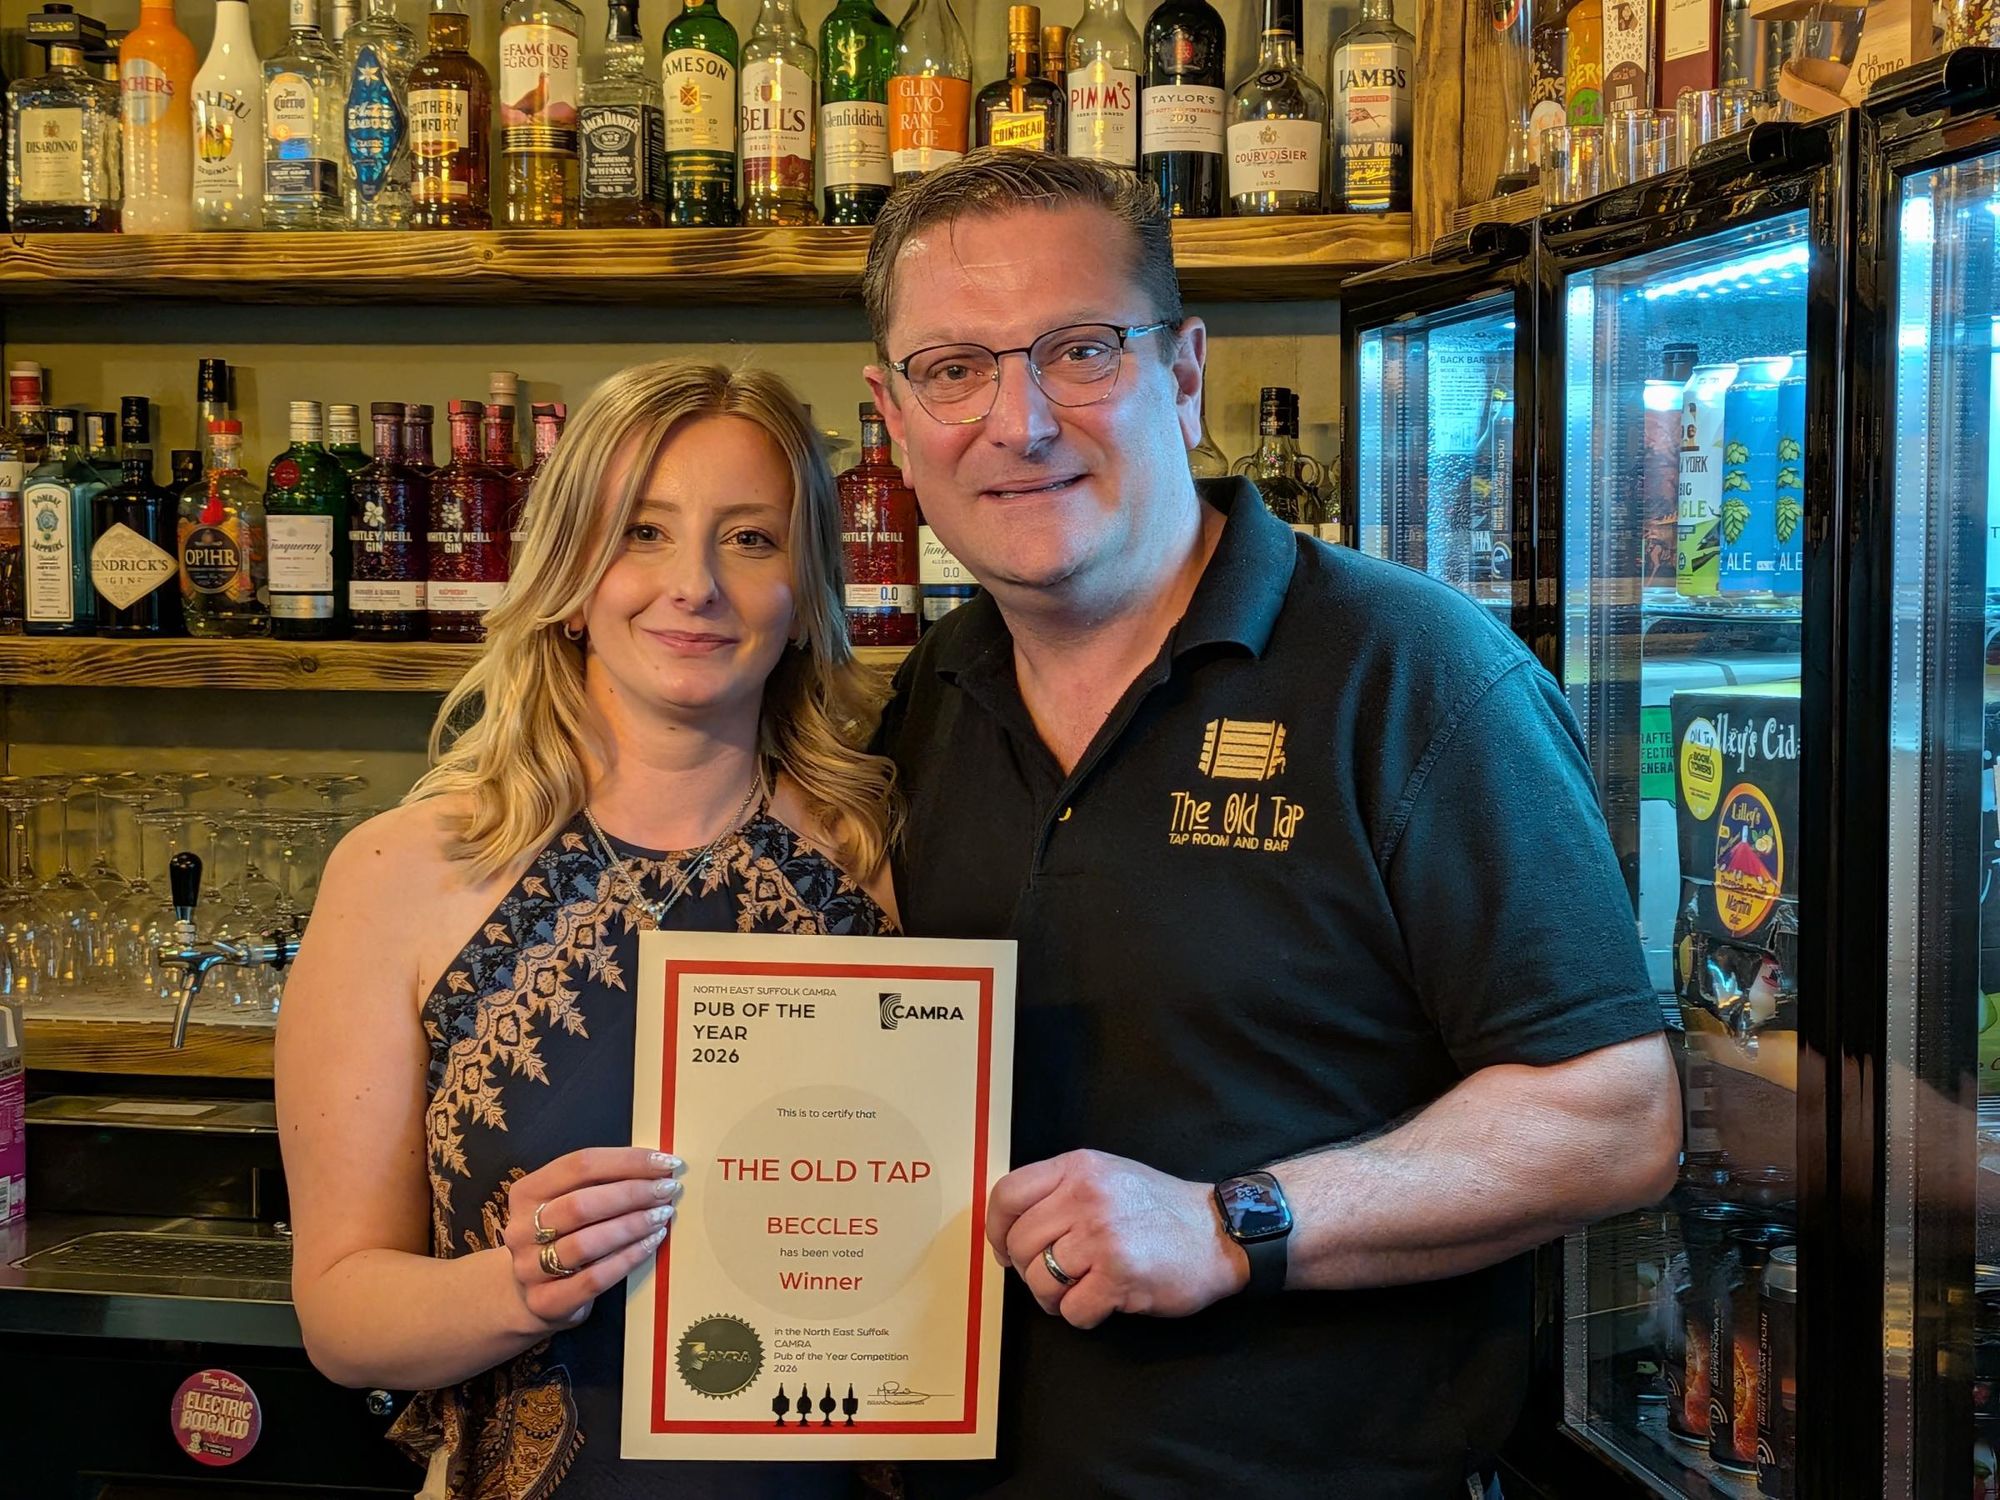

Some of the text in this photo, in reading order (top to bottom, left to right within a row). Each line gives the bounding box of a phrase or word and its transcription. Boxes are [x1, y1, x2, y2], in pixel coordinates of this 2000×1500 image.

[509, 43, 569, 58] FAMOUS
[508, 57, 569, 71] GROUSE
[1867, 53, 1878, 66] La
[1340, 67, 1407, 93] LAMB'S
[900, 79, 943, 97] GLEN
[1071, 81, 1131, 112] PIMM'S
[1152, 95, 1215, 105] TAYLOR'S
[410, 101, 462, 116] SOUTHERN
[911, 96, 944, 113] MO
[411, 118, 459, 134] COMFORT
[581, 114, 605, 134] JACK
[742, 105, 806, 132] BELL'S
[900, 113, 933, 130] RAN
[1170, 114, 1197, 125] 2019
[26, 140, 78, 154] DISARONNO
[1235, 150, 1308, 164] COURVOISIER
[589, 167, 633, 175] WHISKEY
[1262, 170, 1276, 178] VS
[1440, 355, 1465, 364] BACK
[1467, 355, 1487, 364] BAR
[1685, 456, 1708, 473] YORK
[385, 532, 413, 542] NEILL
[463, 532, 491, 543] NEILL
[877, 531, 904, 543] NEILL
[366, 542, 383, 552] GIN
[445, 543, 462, 553] GIN
[185, 549, 239, 566] OPIHR
[1726, 552, 1752, 571] ALE
[1780, 551, 1803, 571] ALE
[943, 567, 960, 578] 0.0
[110, 577, 136, 585] GIN
[880, 586, 898, 601] 0.0
[1170, 791, 1212, 831] The
[1224, 792, 1259, 835] Old
[1731, 803, 1761, 828] Lilley's
[1169, 833, 1290, 851] TAP ROOM AND BAR
[1725, 893, 1753, 916] Martini
[693, 985, 837, 997] NORTH EAST SUFFOLK CAMRA
[693, 1002, 816, 1018] PUB OF THE
[892, 1005, 965, 1021] CAMRA
[693, 1025, 748, 1041] YEAR
[692, 1048, 740, 1064] 2026
[777, 1107, 877, 1120] This is to certify that
[716, 1158, 931, 1184] THE OLD TAP
[767, 1216, 879, 1236] BECCLES
[780, 1247, 864, 1258] has been voted
[779, 1271, 863, 1291] Winner
[775, 1328, 890, 1337] in the North East Suffolk
[774, 1340, 812, 1349] CAMRA
[773, 1351, 909, 1362] Pub of the Year Competition
[773, 1365, 798, 1373] 2026
[184, 1391, 254, 1421] ELECTRIC
[180, 1410, 250, 1440] BOOGALOO
